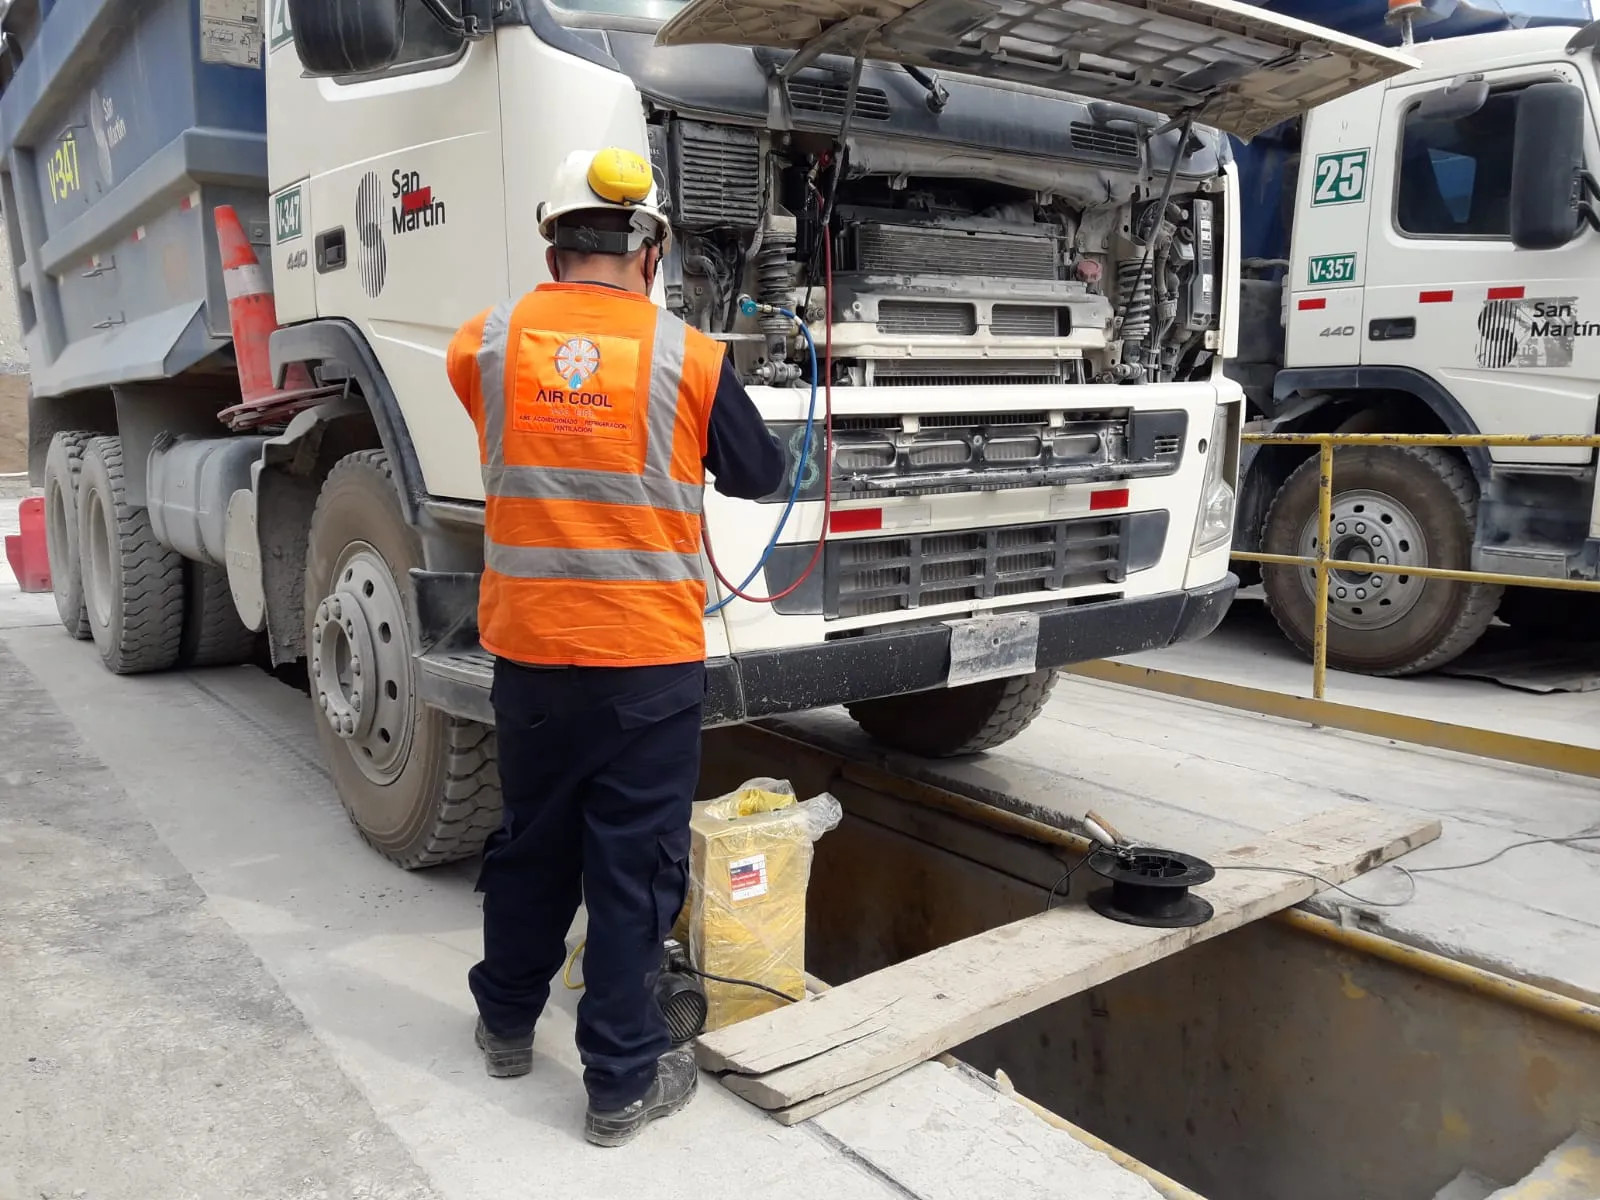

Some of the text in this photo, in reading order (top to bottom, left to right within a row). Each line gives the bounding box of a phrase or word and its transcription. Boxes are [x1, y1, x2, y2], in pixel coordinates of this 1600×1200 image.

[47, 131, 80, 204] V-347
[1315, 154, 1364, 201] 25
[391, 168, 420, 199] San
[276, 195, 300, 235] V-347
[392, 196, 446, 235] Martín
[286, 248, 308, 270] 440
[1311, 257, 1354, 281] V-357
[1533, 301, 1572, 318] San
[1319, 325, 1355, 338] 440
[1530, 320, 1600, 337] Martín
[536, 389, 613, 408] AIR COOL
